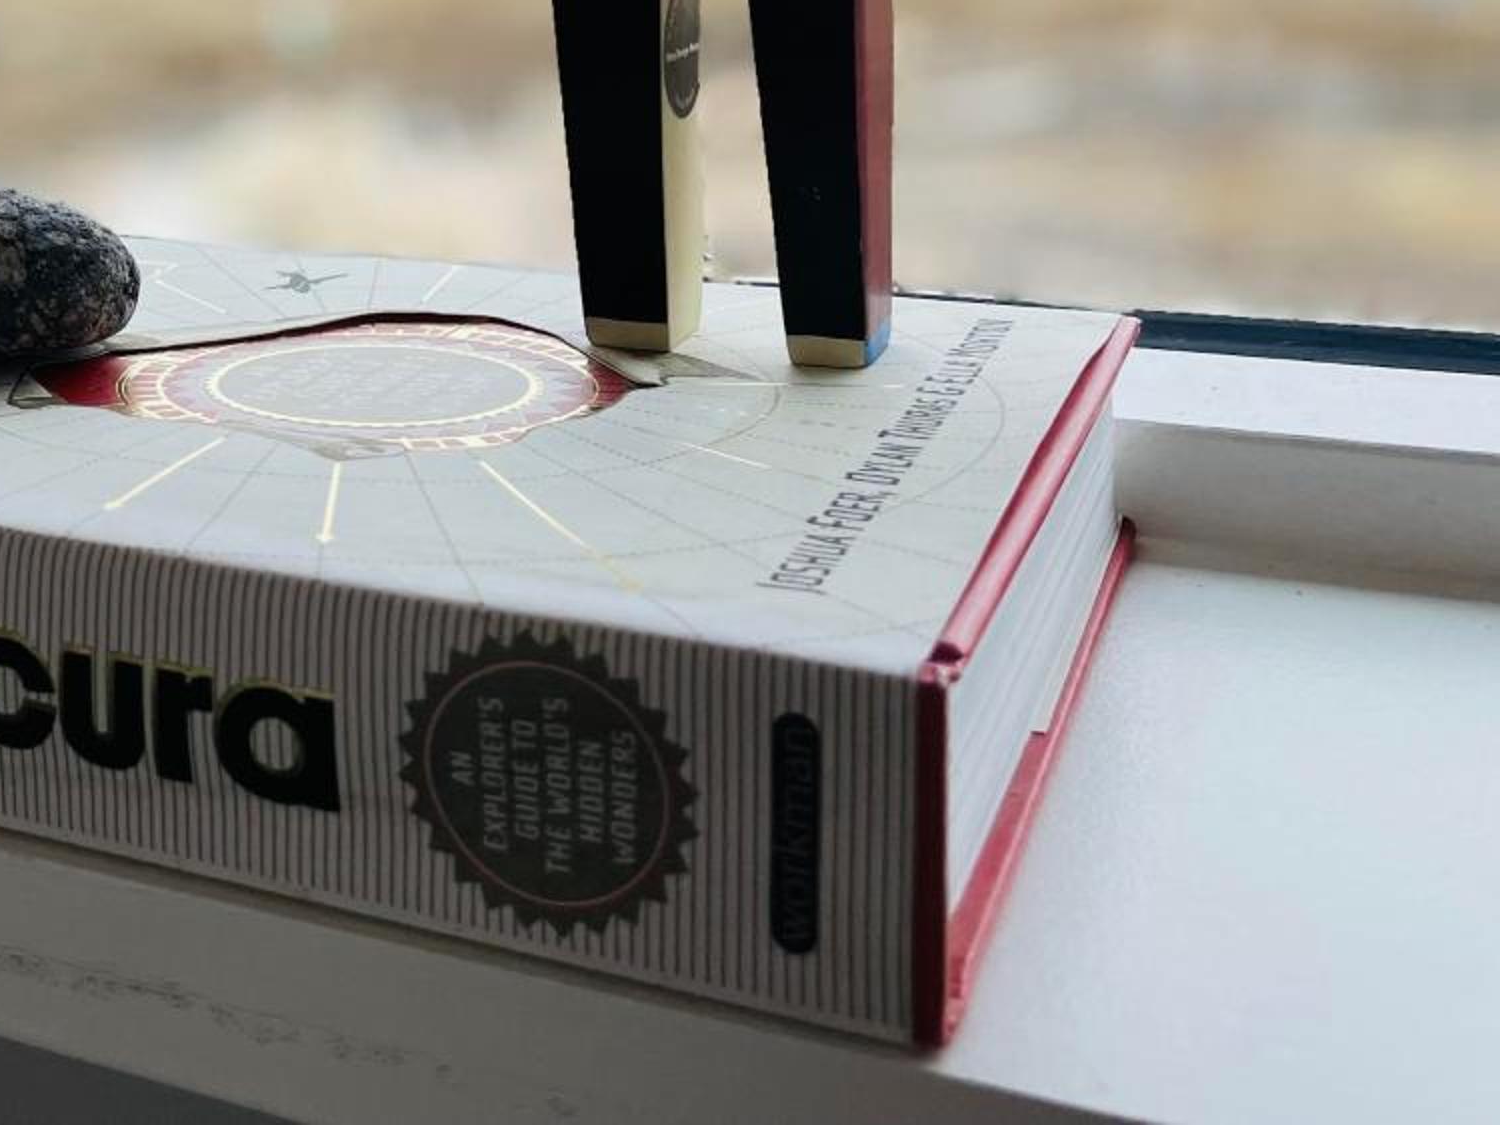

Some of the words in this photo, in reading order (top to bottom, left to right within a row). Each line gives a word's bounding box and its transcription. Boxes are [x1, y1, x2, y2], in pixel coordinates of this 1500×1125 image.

[877, 399, 958, 440] THURAS
[844, 442, 924, 486] DYLAN
[806, 490, 899, 532] FOER,
[755, 533, 857, 595] JOSHUA
[511, 719, 537, 750] TO
[542, 697, 571, 815] WORLD'S
[450, 749, 476, 787] AN
[477, 696, 508, 851] EXPLORER'S
[577, 740, 604, 843] HIDDEN
[512, 761, 540, 841] GUIDE
[611, 730, 638, 865] WONDERS
[545, 824, 572, 874] THE
